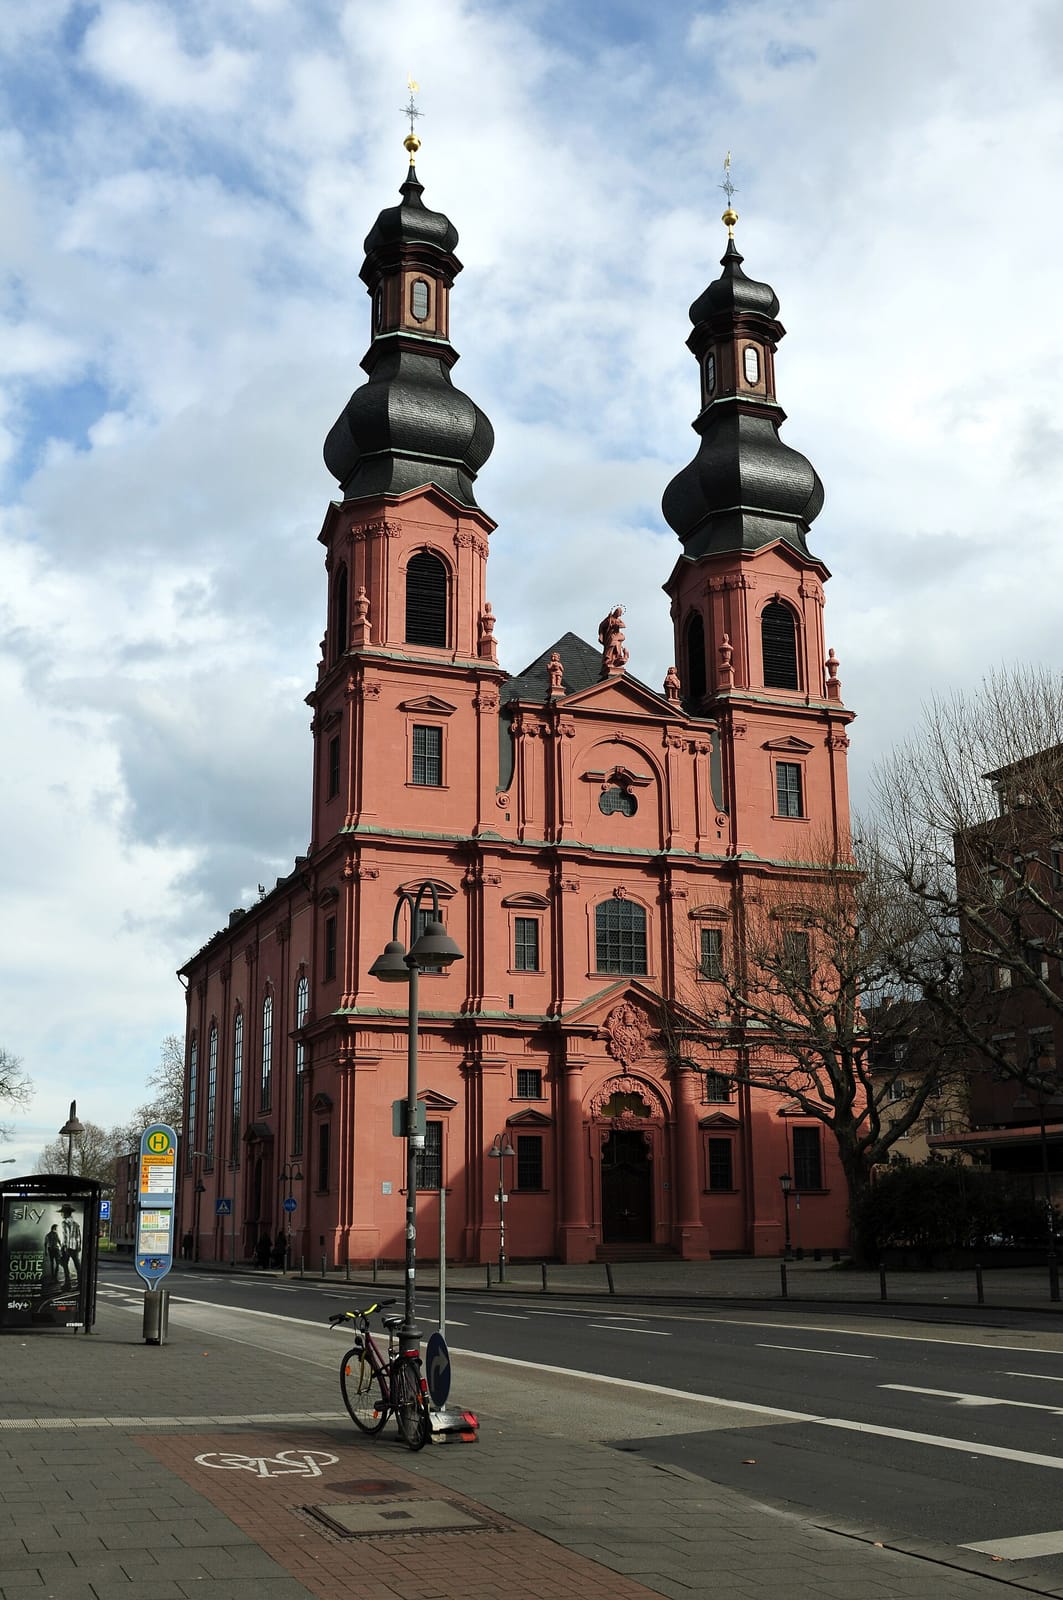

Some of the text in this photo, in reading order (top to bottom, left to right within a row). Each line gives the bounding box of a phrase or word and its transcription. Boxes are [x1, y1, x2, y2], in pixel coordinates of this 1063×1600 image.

[153, 1135, 165, 1149] H
[101, 1202, 108, 1212] P
[12, 1204, 46, 1225] sky
[9, 1260, 44, 1272] GUTE
[8, 1271, 43, 1281] STORY?
